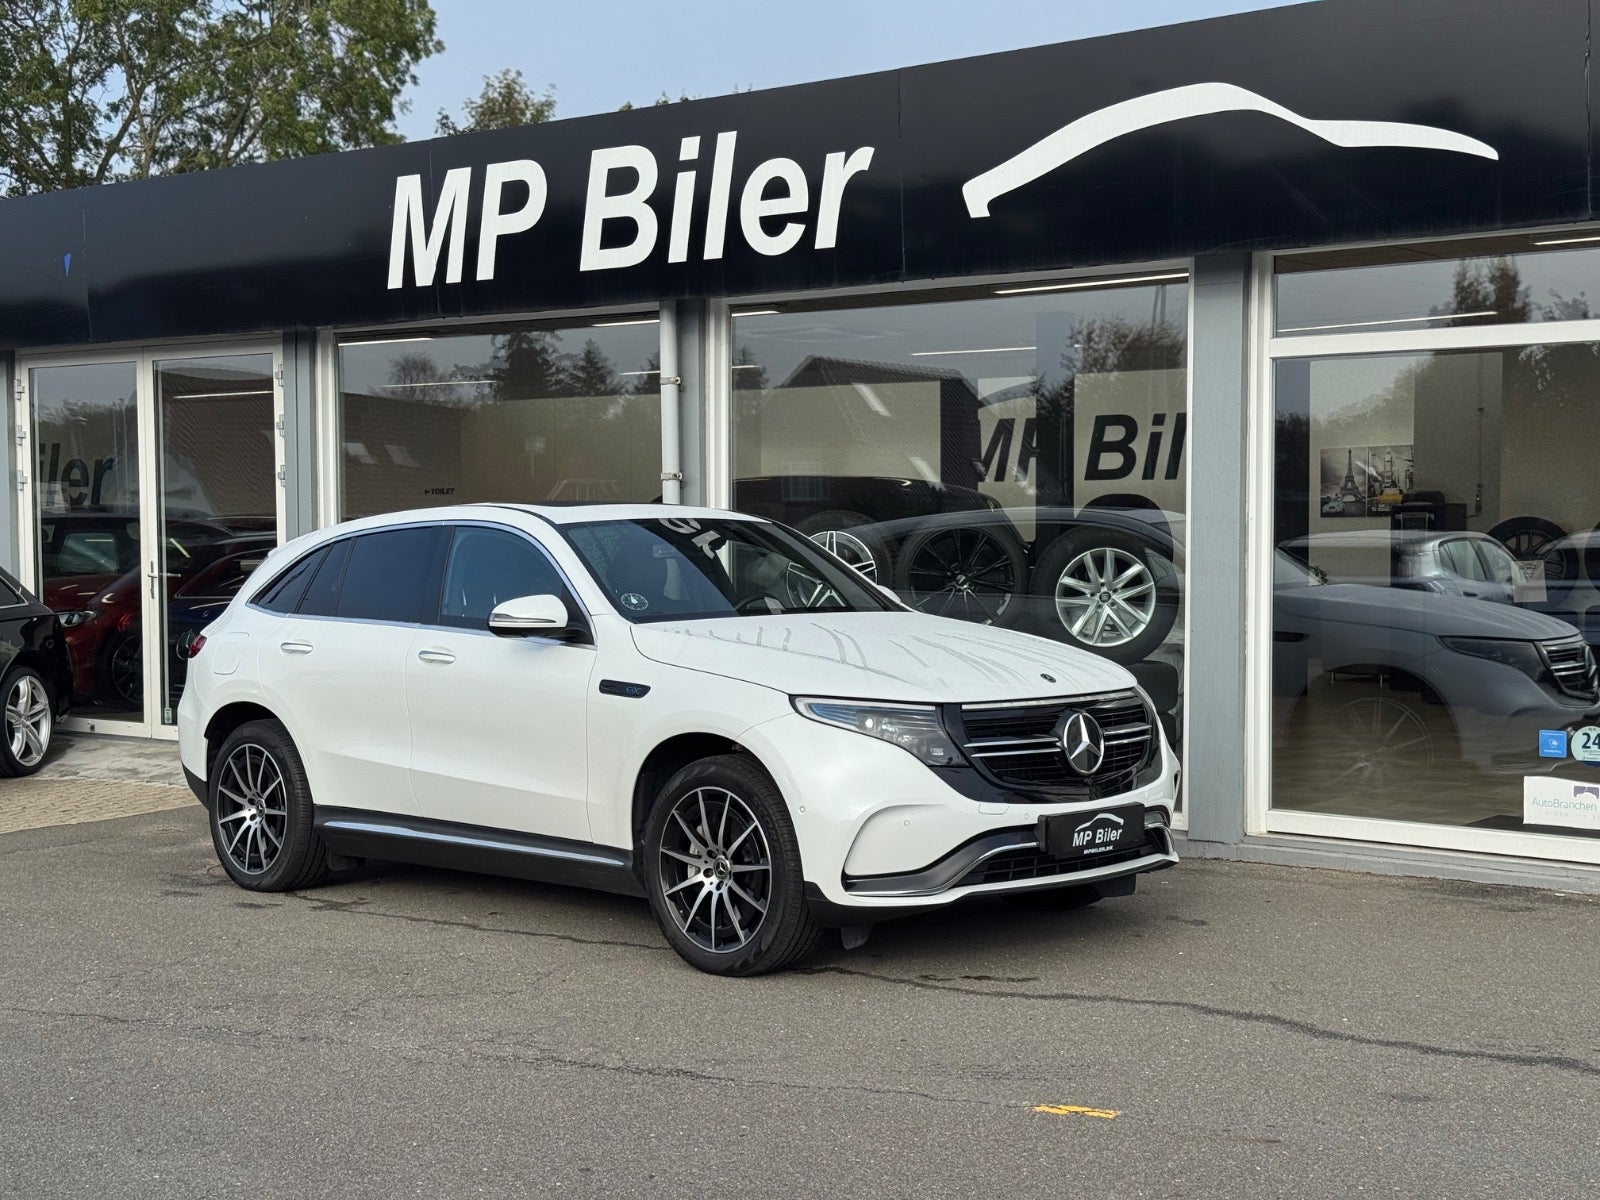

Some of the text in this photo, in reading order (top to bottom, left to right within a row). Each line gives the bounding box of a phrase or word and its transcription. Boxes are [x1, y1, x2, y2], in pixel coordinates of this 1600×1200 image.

[388, 131, 875, 290] MP Biler
[431, 487, 456, 495] TOILET
[1531, 797, 1598, 811] AutoBranchen
[1072, 828, 1123, 847] MP Biler
[1083, 846, 1113, 854] MPBILER.DK
